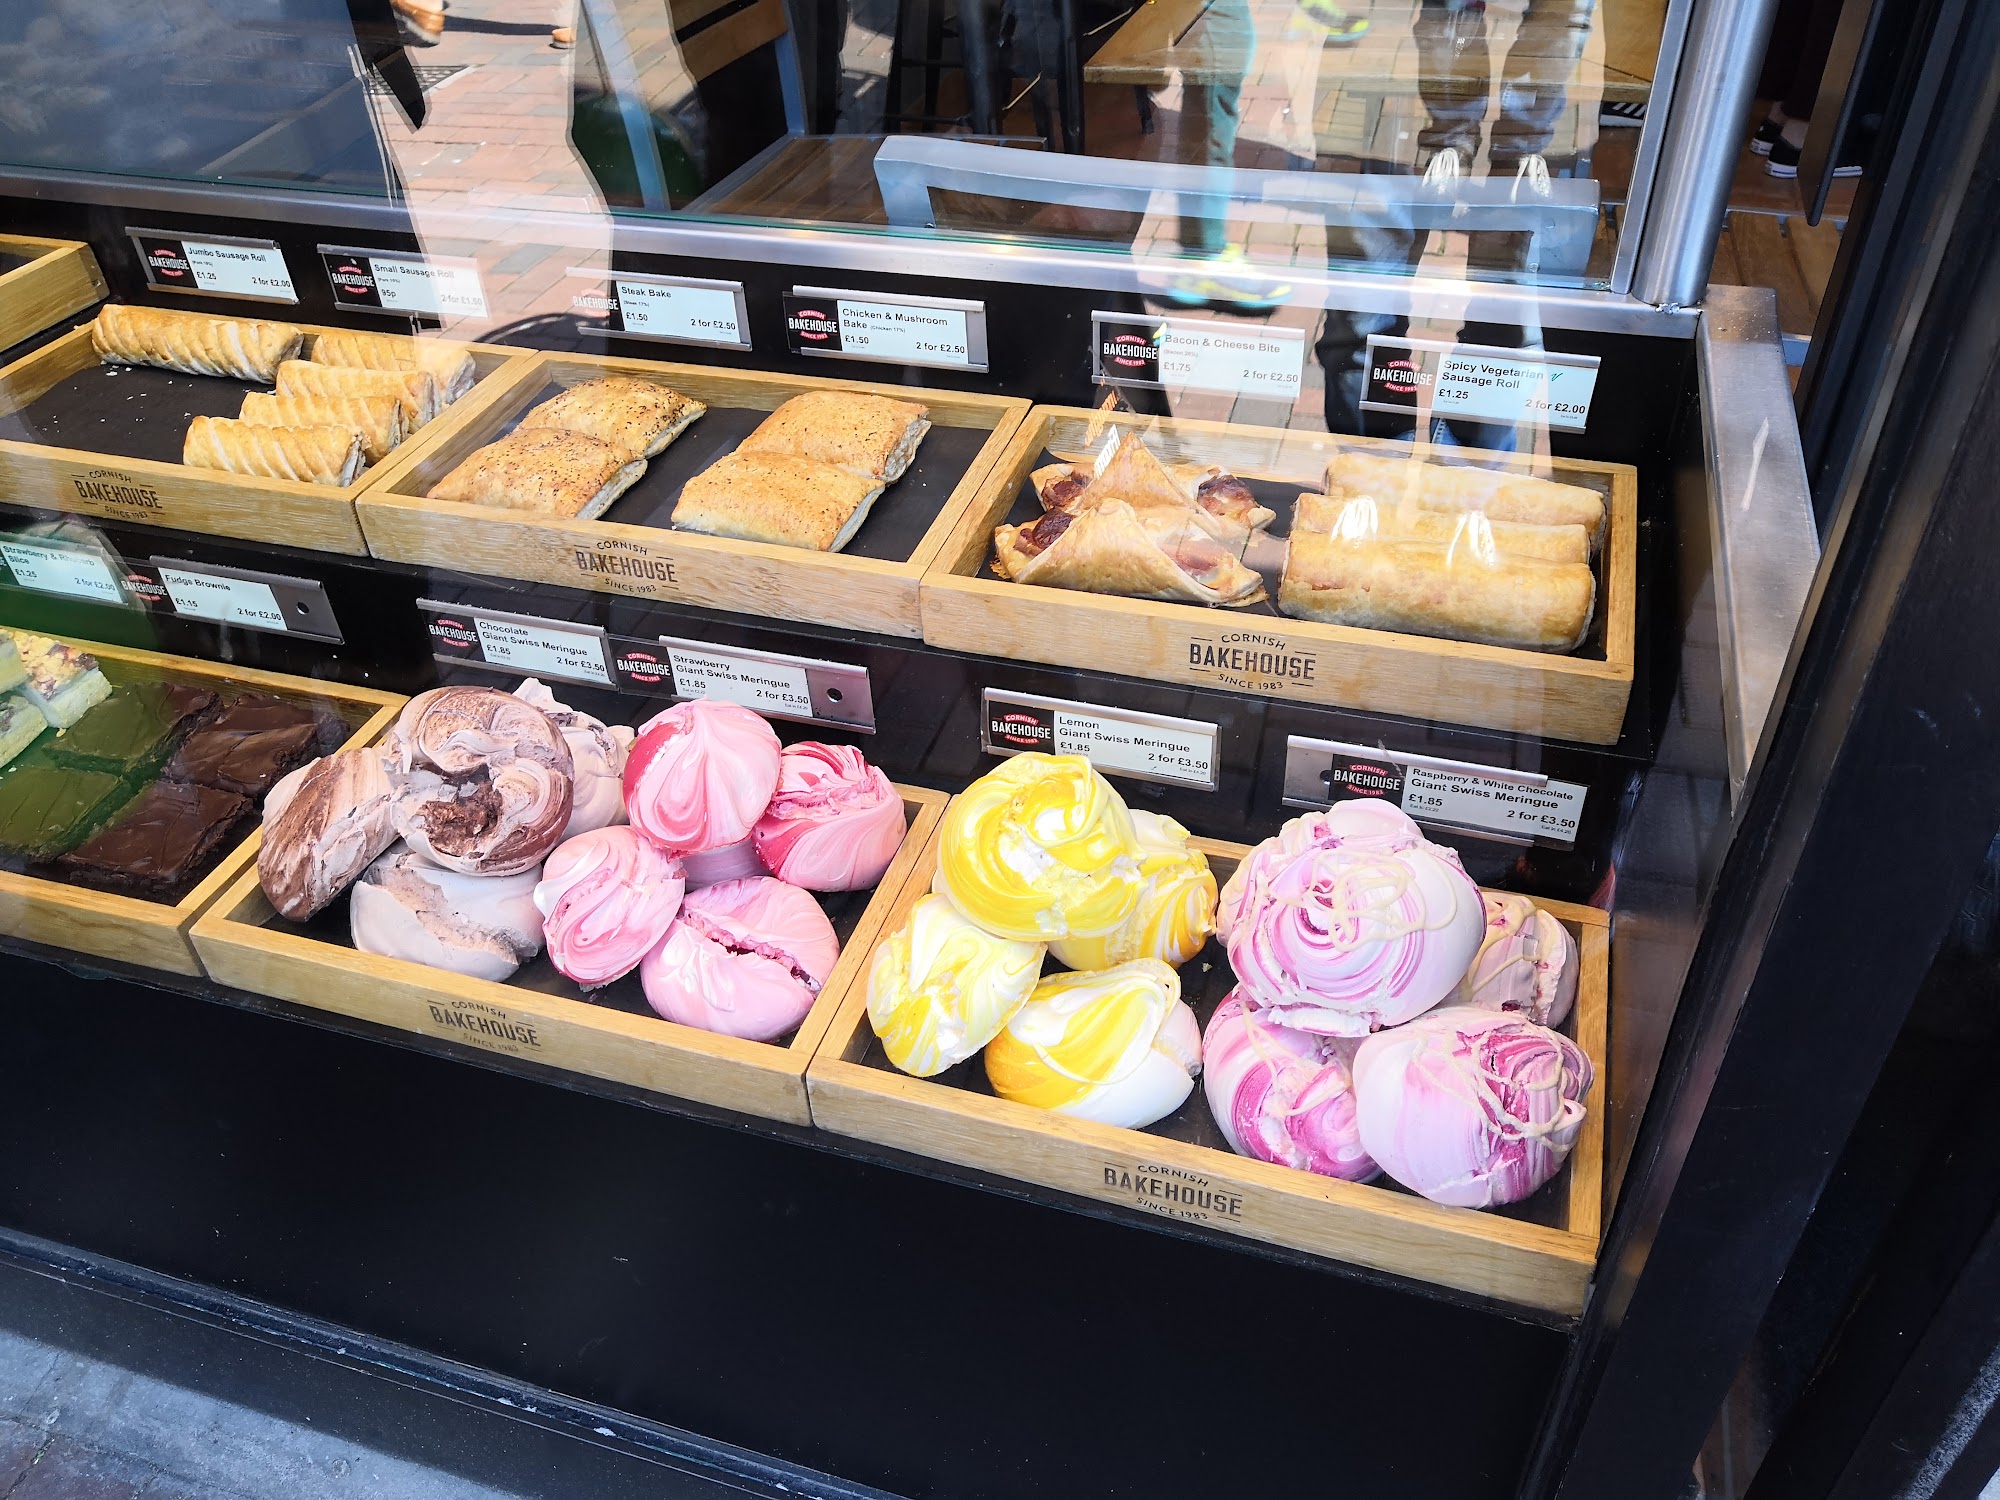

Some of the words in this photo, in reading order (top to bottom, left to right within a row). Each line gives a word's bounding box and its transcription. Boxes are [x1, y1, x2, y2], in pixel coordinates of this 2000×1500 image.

[188, 247, 213, 257] Jumbo
[216, 250, 248, 262] Sausage
[251, 253, 266, 262] Roll
[149, 256, 189, 270] BAKEHOUSE
[197, 271, 216, 280] £1.25
[374, 264, 398, 273] Small
[400, 267, 435, 278] Sausage
[438, 269, 454, 278] Roll
[252, 276, 257, 284] 2
[270, 279, 290, 288] £2.00
[332, 273, 375, 287] BAKEHOUSE
[381, 289, 396, 297] 95p
[621, 286, 646, 296] Steak
[648, 289, 672, 298] Bake
[442, 294, 446, 302] 2
[447, 294, 459, 303] for
[461, 296, 482, 306] £1.50
[572, 296, 619, 310] BAKEHOUSE
[626, 312, 648, 322] £1.50
[798, 310, 825, 319] CORNISH
[842, 309, 882, 320] Chicken
[895, 314, 948, 326] Mushroom
[698, 319, 710, 328] for
[713, 320, 736, 330] £2.50
[788, 318, 837, 333] BAKEHOUSE
[844, 320, 867, 329] Bake
[845, 334, 869, 344] £1.50
[1116, 335, 1145, 345] CORNISH
[1165, 335, 1199, 346] Bacon
[1203, 338, 1210, 347] &
[1214, 339, 1255, 351] Cheese
[1259, 343, 1281, 353] Bite
[916, 342, 922, 350] 2
[924, 343, 937, 351] for
[940, 344, 965, 354] £2.50
[1104, 342, 1157, 360] BAKEHOUSE
[1164, 362, 1191, 372] £1.75
[1387, 360, 1421, 370] CORNISH
[1444, 360, 1477, 374] Spicy
[1480, 364, 1544, 380] Vegetarian
[1243, 370, 1249, 378] 2
[1252, 370, 1267, 380] for
[1270, 372, 1298, 383] £2.50
[1373, 368, 1433, 386] BAKEHOUSE
[1442, 372, 1492, 386] Sausage
[1496, 378, 1521, 389] Roll
[1438, 389, 1469, 399] £1.25
[1525, 399, 1532, 407] 2
[1535, 400, 1551, 410] for
[1554, 402, 1586, 414] £2.00
[89, 470, 132, 483] CORNISH
[74, 480, 162, 509] BAKEHOUSE
[104, 506, 130, 518] SINCE
[3, 546, 48, 560] Strawberry
[597, 541, 648, 555] CORNISH
[8, 555, 30, 565] Slice
[576, 551, 678, 582] BAKEHOUSE
[15, 569, 37, 578] £1.25
[82, 579, 92, 587] for
[94, 582, 116, 591] £2.00
[121, 581, 167, 596] BAKEHOUSE
[164, 574, 193, 587] Fudge
[194, 579, 231, 591] Brownie
[605, 578, 635, 592] SINCE
[637, 585, 656, 593] 1983
[175, 598, 198, 608] £1.15
[237, 608, 243, 616] 2
[245, 609, 257, 618] for
[258, 611, 281, 621] £2.00
[429, 624, 478, 643] BAKEHOUSE
[479, 622, 529, 636] Chocolate
[483, 632, 508, 643] Giant
[510, 636, 540, 648] Swiss
[542, 641, 588, 656] Meringue
[1222, 634, 1286, 650] CORNISH
[487, 645, 511, 655] £1.85
[565, 658, 578, 667] for
[581, 661, 605, 672] £3.50
[617, 659, 670, 676] BAKEHOUSE
[673, 654, 730, 671] Strawberry
[1190, 644, 1316, 680] BAKEHOUSE
[676, 665, 704, 677] Giant
[706, 669, 738, 681] Swiss
[740, 674, 791, 689] Meringue
[680, 678, 706, 689] £1.85
[1218, 673, 1253, 689] SINCE
[1258, 682, 1283, 690] 1983
[756, 690, 762, 698] 2
[765, 690, 779, 700] for
[782, 692, 809, 705] £3.50
[1004, 714, 1038, 725] CORNISH
[1059, 717, 1100, 730] Lemon
[992, 720, 1051, 739] BAKEHOUSE
[1059, 728, 1091, 739] Giant
[1094, 732, 1130, 744] Swiss
[1134, 737, 1191, 753] Meringue
[1060, 741, 1090, 752] £1.85
[1148, 753, 1155, 761] 2
[1158, 754, 1175, 764] for
[1178, 757, 1208, 770] £3.50
[1351, 764, 1387, 775] CORNISH
[1334, 770, 1401, 791] BAKEHOUSE
[1412, 768, 1469, 785] Raspberry
[1472, 776, 1480, 784] &
[1483, 778, 1514, 790] White
[1517, 784, 1574, 801] Chocolate
[1348, 785, 1366, 794] SINCE
[1411, 778, 1447, 792] Giant
[1450, 784, 1490, 798] Swiss
[1494, 791, 1558, 809] Meringue
[1408, 794, 1443, 807] £1.85
[1507, 810, 1515, 818] 2
[1518, 812, 1538, 823] for
[1540, 815, 1576, 829] £3.50
[451, 1001, 506, 1019] CORNISH
[429, 1005, 541, 1046] BAKEHOUSE
[463, 1033, 496, 1049] SINCE
[1138, 1165, 1209, 1187] CORNISH
[1104, 1168, 1242, 1216] BAKEHOUSE
[1136, 1197, 1176, 1216] SINCE
[1180, 1211, 1208, 1220] 1983
